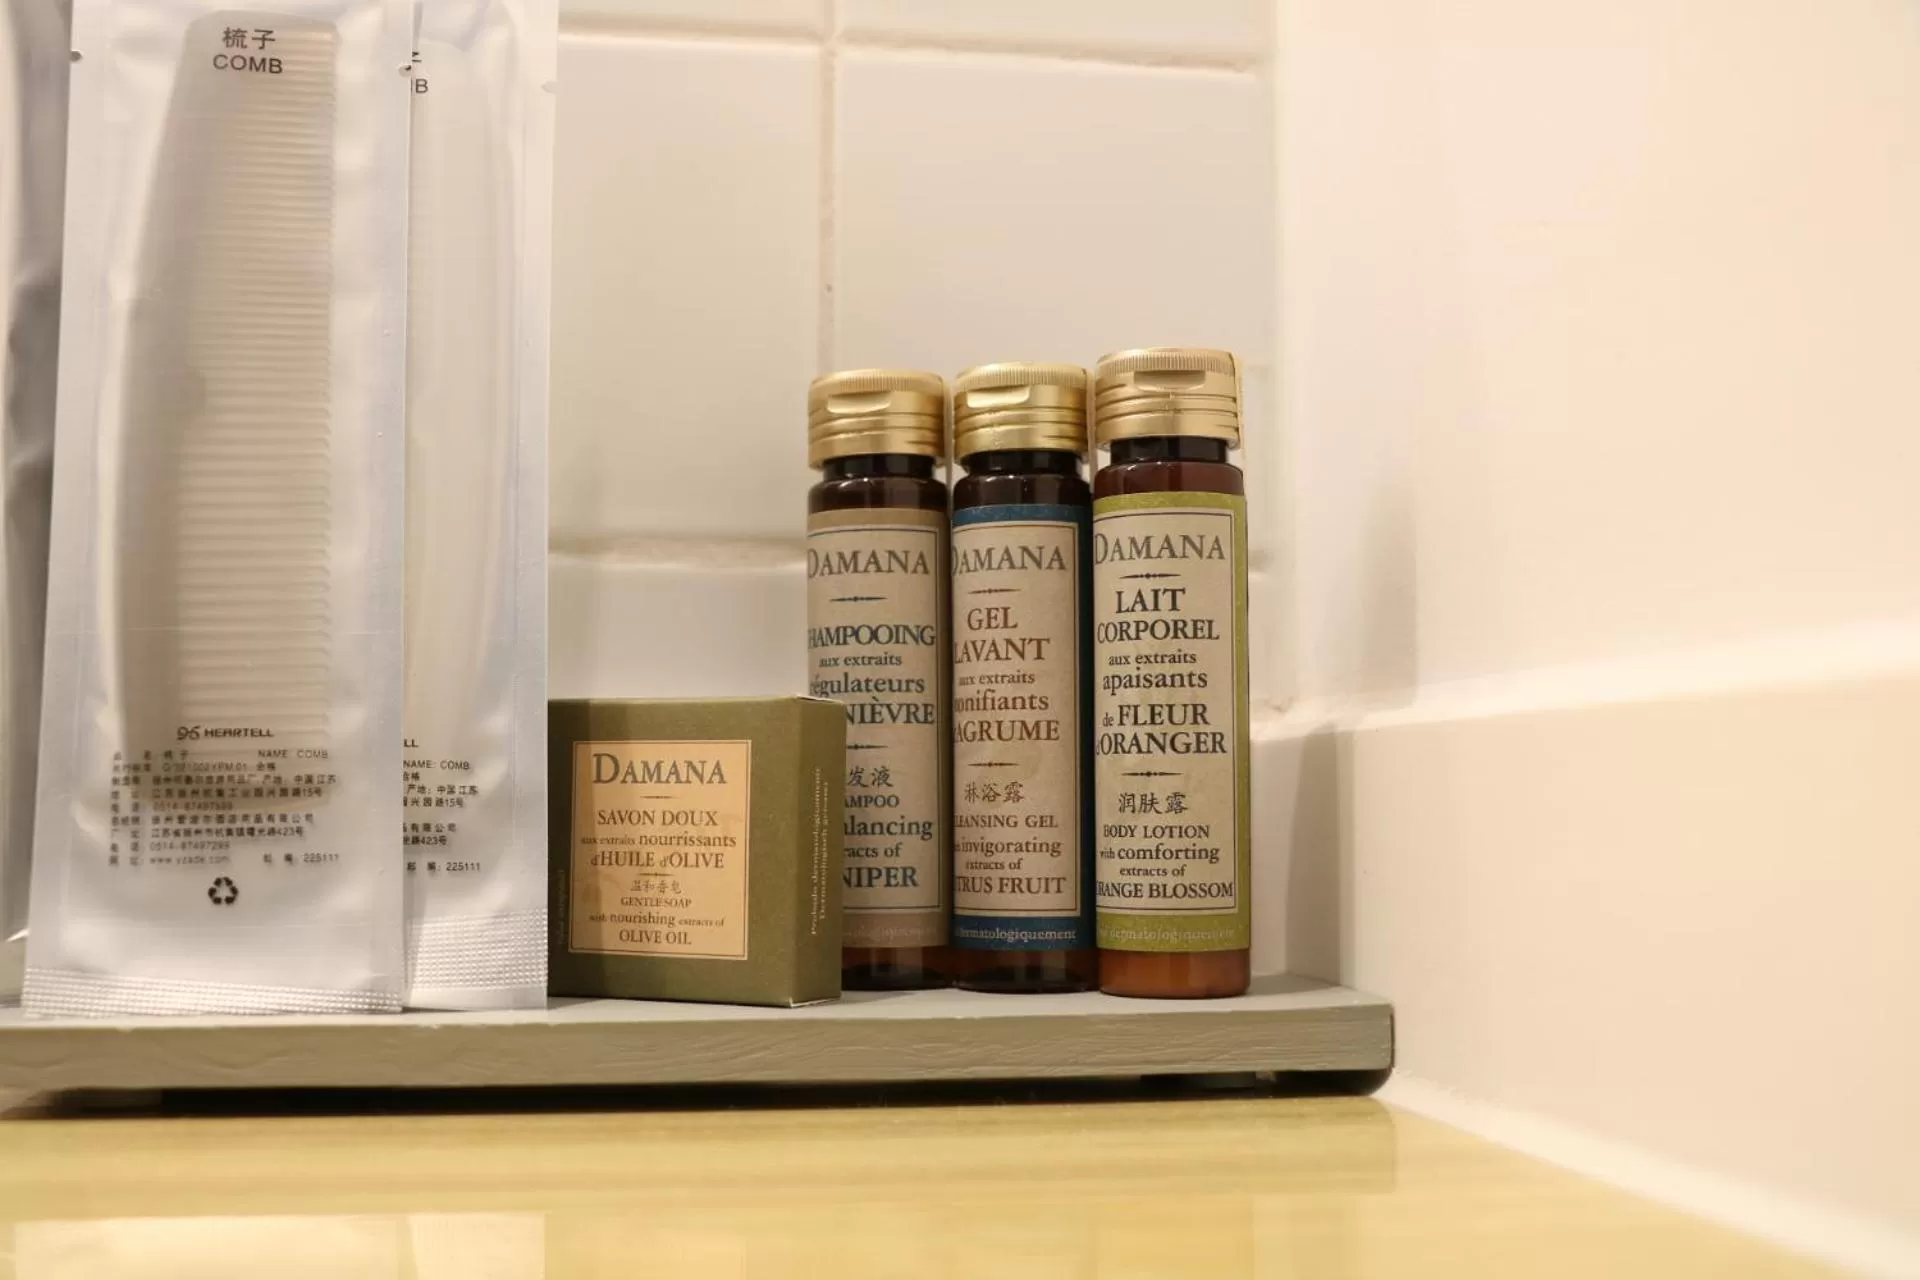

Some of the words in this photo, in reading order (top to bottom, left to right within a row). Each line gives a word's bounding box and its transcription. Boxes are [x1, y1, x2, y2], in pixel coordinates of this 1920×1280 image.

[222, 27, 276, 50] 梳子
[213, 54, 283, 74] COMB
[1094, 533, 1226, 565] DAMANA
[1115, 587, 1186, 614] LAIT
[967, 606, 1018, 631] GEL
[808, 624, 936, 649] HAMPOOING
[1097, 619, 1220, 644] CORPOREL
[819, 656, 840, 667] aux
[843, 652, 903, 667] extraits
[954, 637, 1050, 664] LAVANT
[1108, 655, 1131, 667] aux
[1135, 649, 1197, 665] extraits
[979, 670, 1035, 685] extraits
[1103, 667, 1209, 696] apaisants
[845, 696, 935, 725] NIÈVRE
[1102, 712, 1115, 727] de
[1117, 703, 1211, 727] FLEUR
[204, 727, 274, 738] HEARTELL
[440, 761, 471, 770] COMB
[593, 753, 727, 784] DAMANA
[848, 765, 894, 788] 发液
[964, 780, 1024, 803] 淋浴露
[1118, 792, 1188, 815] 润肤露
[597, 810, 655, 826] SAVON
[661, 810, 718, 827] DOUX
[954, 814, 1018, 828] LEANSING
[1025, 815, 1059, 828] GEL
[639, 831, 737, 847] nourrissants
[1103, 824, 1137, 838] BODY
[1143, 825, 1210, 839] LOTION
[883, 842, 903, 858] of
[961, 836, 1063, 857] invigorating
[1117, 843, 1220, 864] comforting
[446, 861, 481, 872] 225111
[590, 851, 655, 867] d'HUILE
[659, 853, 725, 869] d'OLIVE
[965, 861, 1005, 870] extracts
[1008, 858, 1024, 870] of
[843, 866, 919, 889] NIPER
[1119, 867, 1168, 877] extracts
[1171, 864, 1188, 877] of
[998, 876, 1067, 894] FRUIT
[1097, 881, 1144, 898] RANGE
[1148, 881, 1234, 899] BLOSSOM
[620, 896, 664, 908] GENTLE
[664, 898, 692, 910] SOAP
[609, 911, 675, 928] nourishing
[678, 917, 713, 927] extracts
[715, 915, 725, 927] of
[619, 929, 662, 944] OLIVE
[665, 930, 692, 945] OIL
